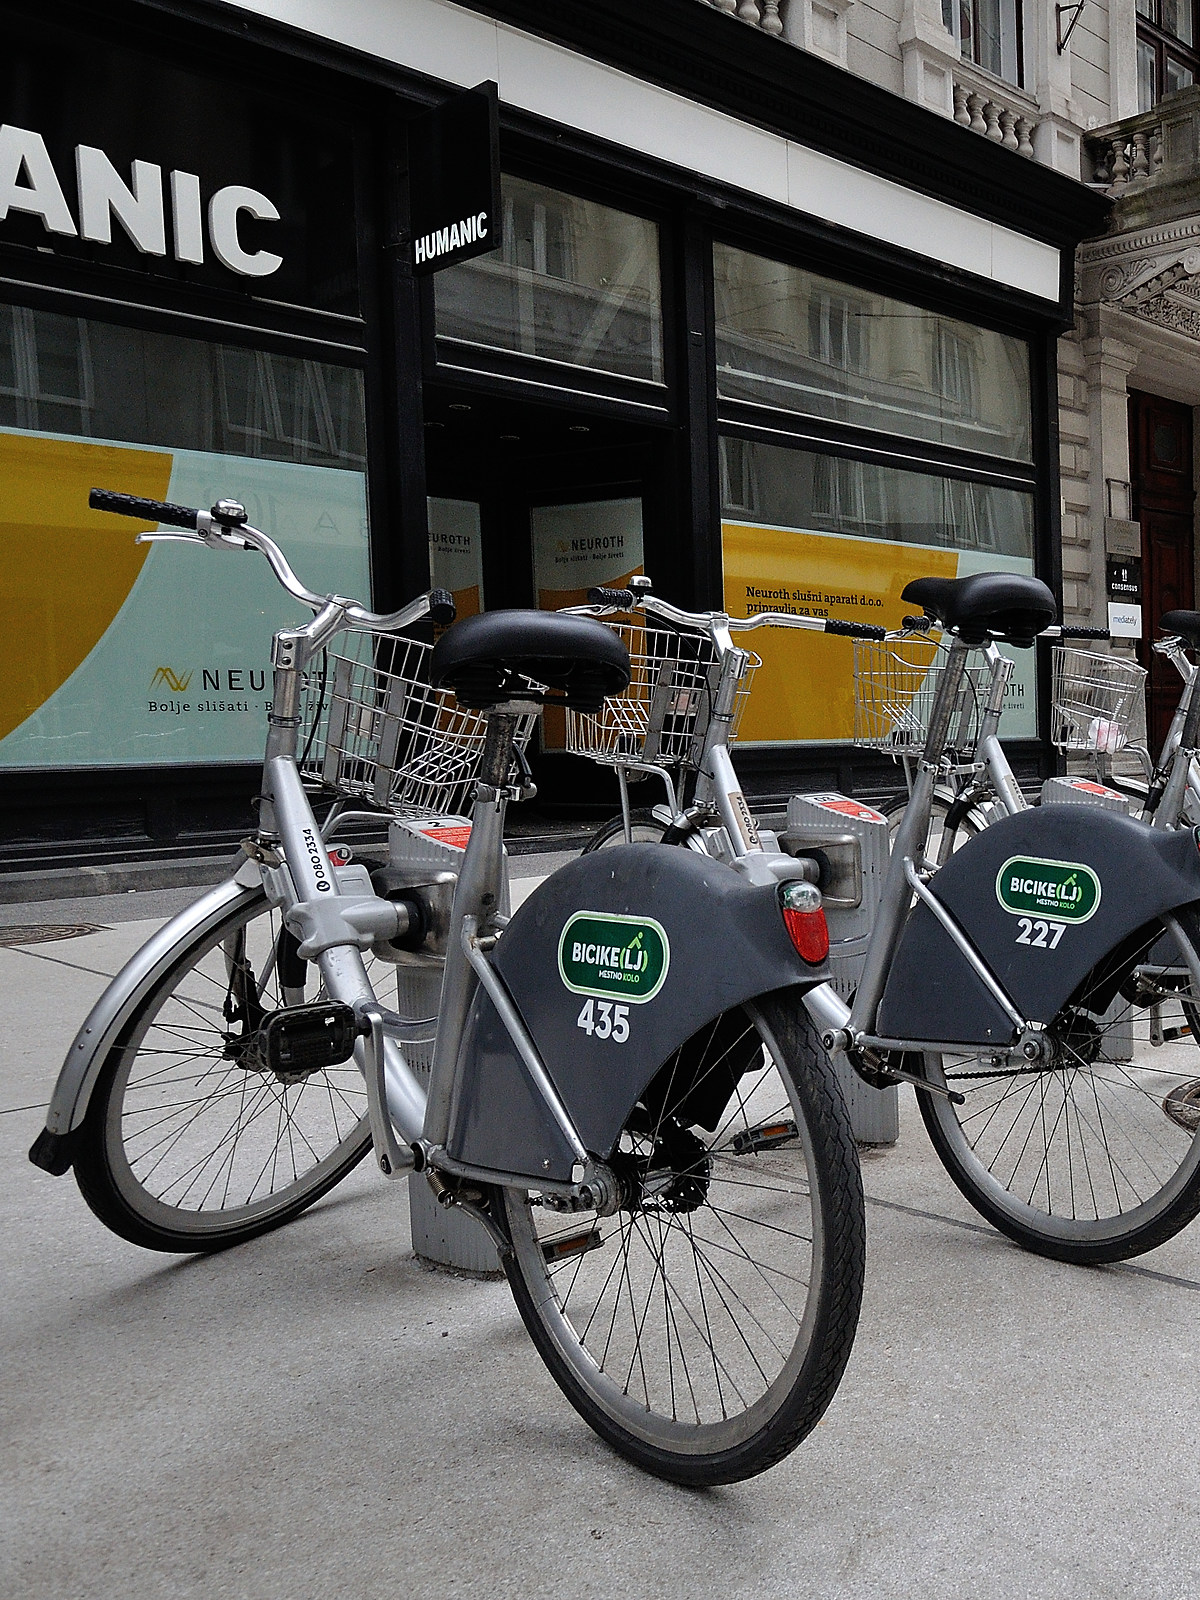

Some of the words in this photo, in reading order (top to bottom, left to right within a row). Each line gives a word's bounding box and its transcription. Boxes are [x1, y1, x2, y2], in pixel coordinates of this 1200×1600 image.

[0, 124, 283, 277] ANIC
[415, 211, 488, 264] HUMANIC
[571, 535, 624, 551] NEUROTH
[746, 586, 790, 600] Neuroth
[792, 590, 822, 603] slušni
[824, 594, 858, 606] aparati
[860, 595, 884, 607] d.o.o.
[799, 607, 810, 616] za
[812, 608, 829, 617] vas
[149, 701, 191, 715] Bolje
[197, 701, 249, 712] slišati
[302, 828, 317, 855] 2334
[311, 856, 326, 879] 080
[1010, 876, 1083, 903] BICIKE(LJ)
[1036, 898, 1059, 907] MESTNO
[1059, 901, 1076, 910] KOLO
[1015, 918, 1067, 950] 227
[572, 941, 649, 973] BICIKE(LJ)
[598, 969, 623, 981] MESTNO
[622, 971, 640, 983] KOLO
[577, 999, 630, 1043] 435
